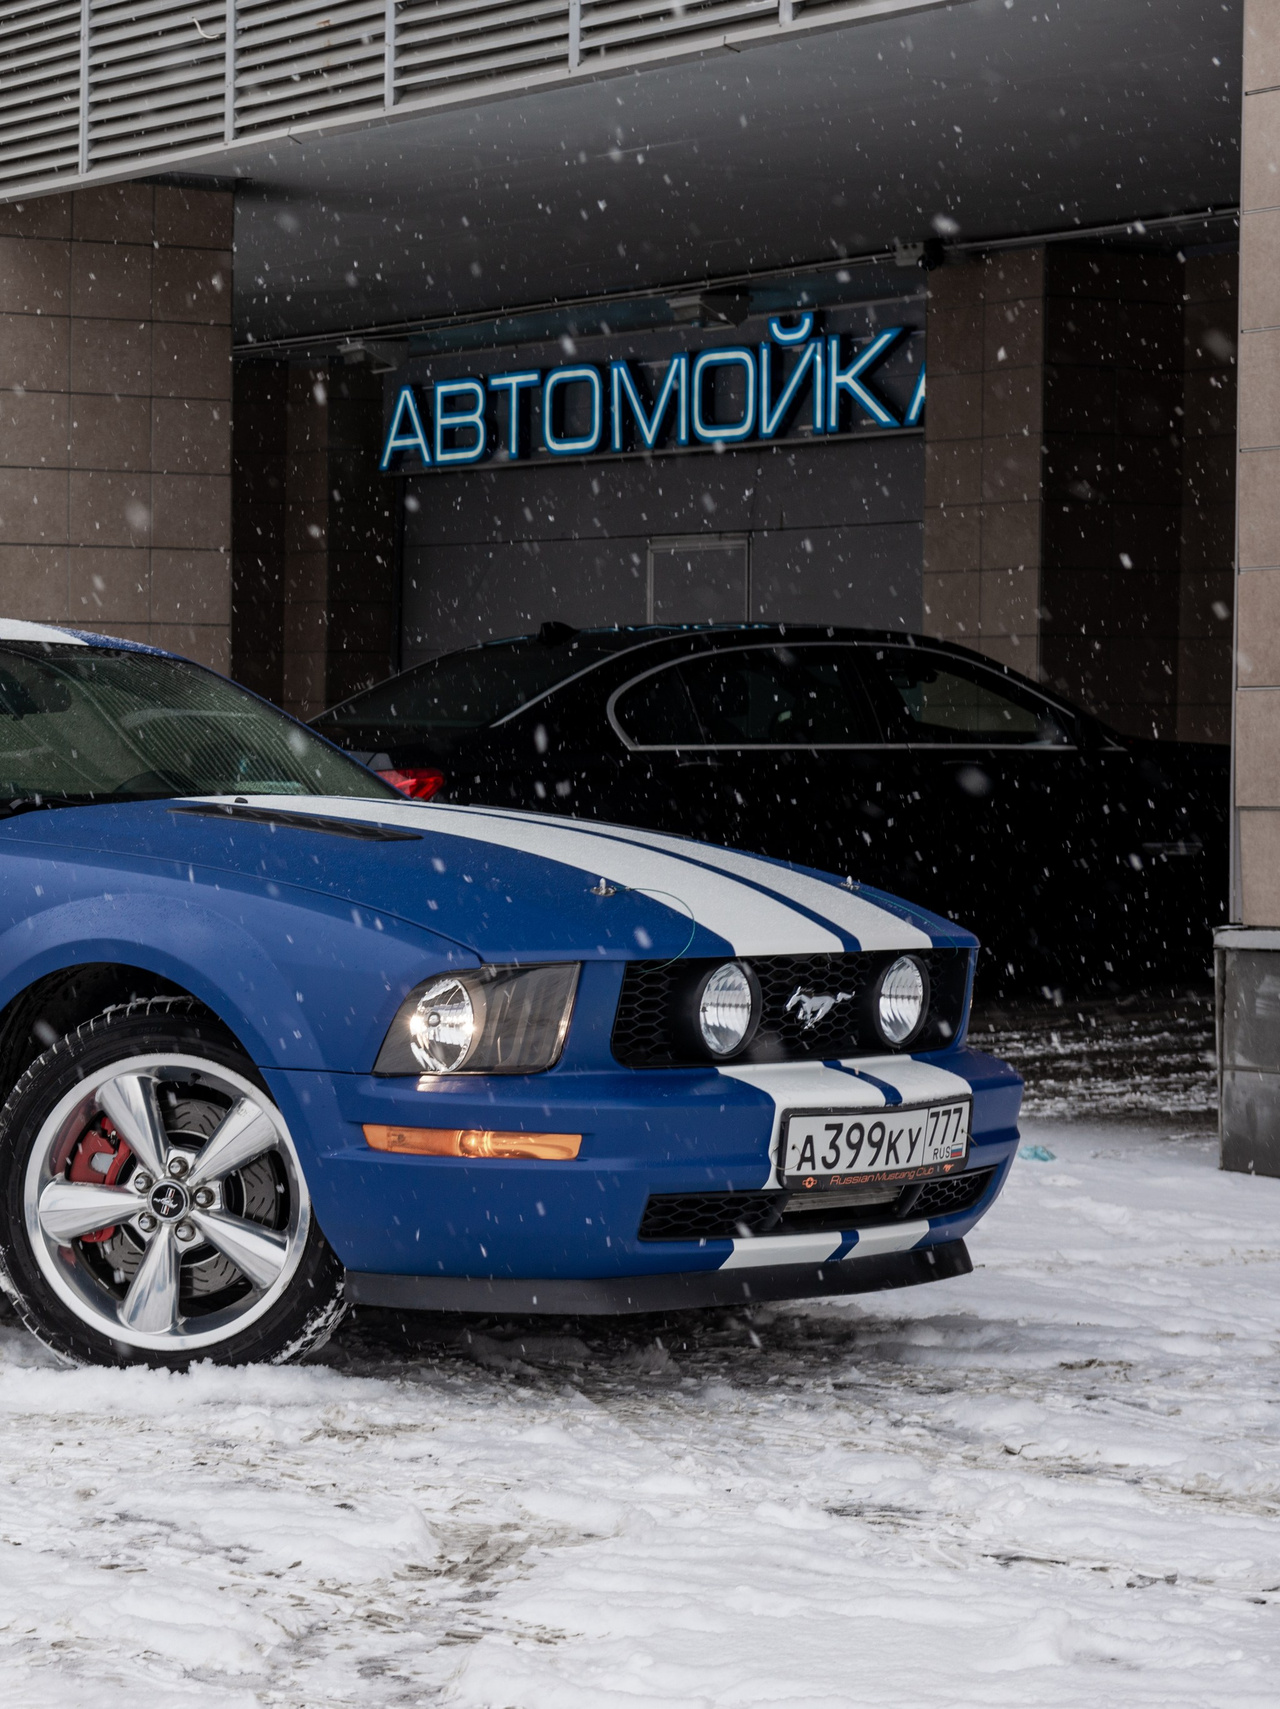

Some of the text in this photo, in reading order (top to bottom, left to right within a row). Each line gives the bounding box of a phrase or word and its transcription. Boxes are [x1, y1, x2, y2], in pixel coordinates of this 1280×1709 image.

[929, 1107, 963, 1147] 777
[932, 1146, 951, 1161] RUS
[829, 1166, 934, 1186] Russian Mustang Club
